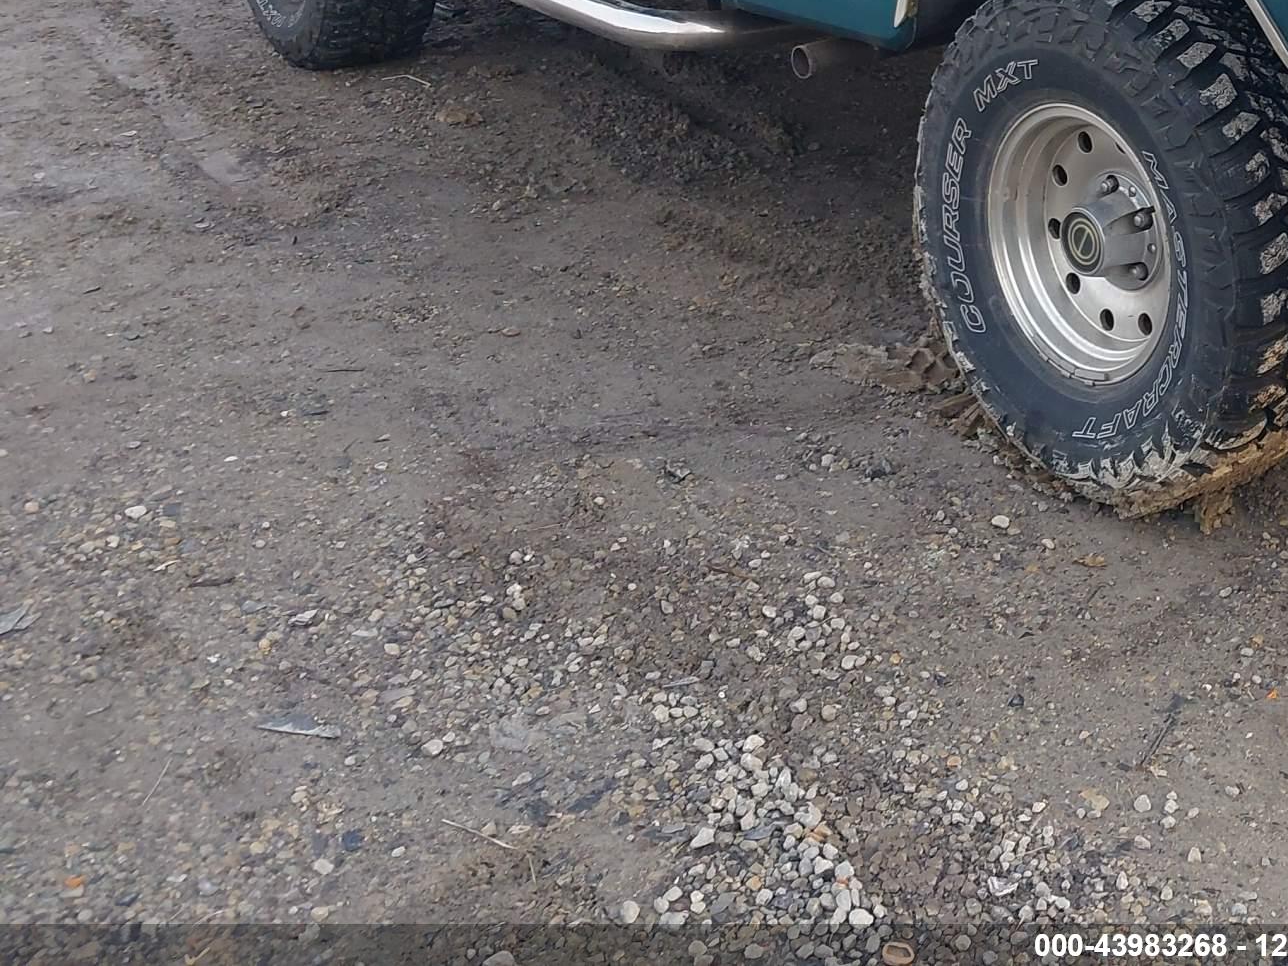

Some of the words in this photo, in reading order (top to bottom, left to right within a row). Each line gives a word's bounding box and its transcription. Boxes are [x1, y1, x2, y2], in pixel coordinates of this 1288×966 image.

[941, 117, 987, 333] COURSER
[972, 58, 1039, 112] MXT
[1072, 150, 1189, 439] MASTERCRAFT
